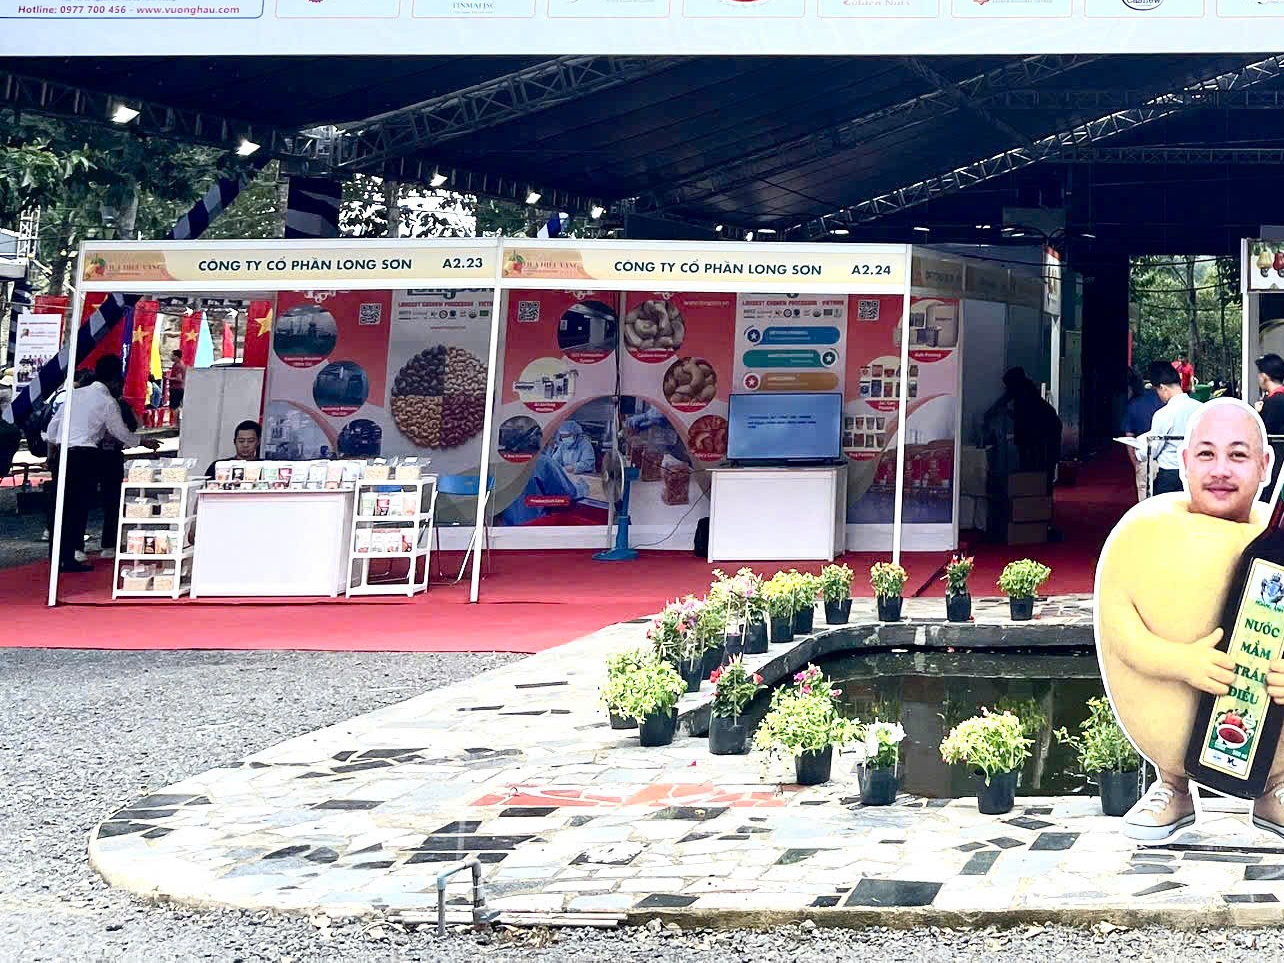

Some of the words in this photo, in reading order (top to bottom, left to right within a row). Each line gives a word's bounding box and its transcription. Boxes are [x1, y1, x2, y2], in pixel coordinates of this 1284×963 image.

[18, 5, 57, 14] Hotline:
[60, 5, 84, 14] 0977
[88, 5, 105, 14] 700
[108, 5, 126, 14] 456
[137, 5, 240, 16] www.vuonghau.com
[198, 257, 241, 271] CÔNG
[246, 260, 262, 271] TY
[336, 259, 377, 270] LONG
[381, 257, 412, 269] SƠN
[442, 257, 483, 269] A2.23
[614, 259, 656, 273] CÔNG
[660, 261, 676, 273] TY
[749, 263, 786, 275] LONG
[792, 263, 821, 276] SƠN
[851, 264, 891, 276] A2.24
[1244, 618, 1280, 638] NƯỚC
